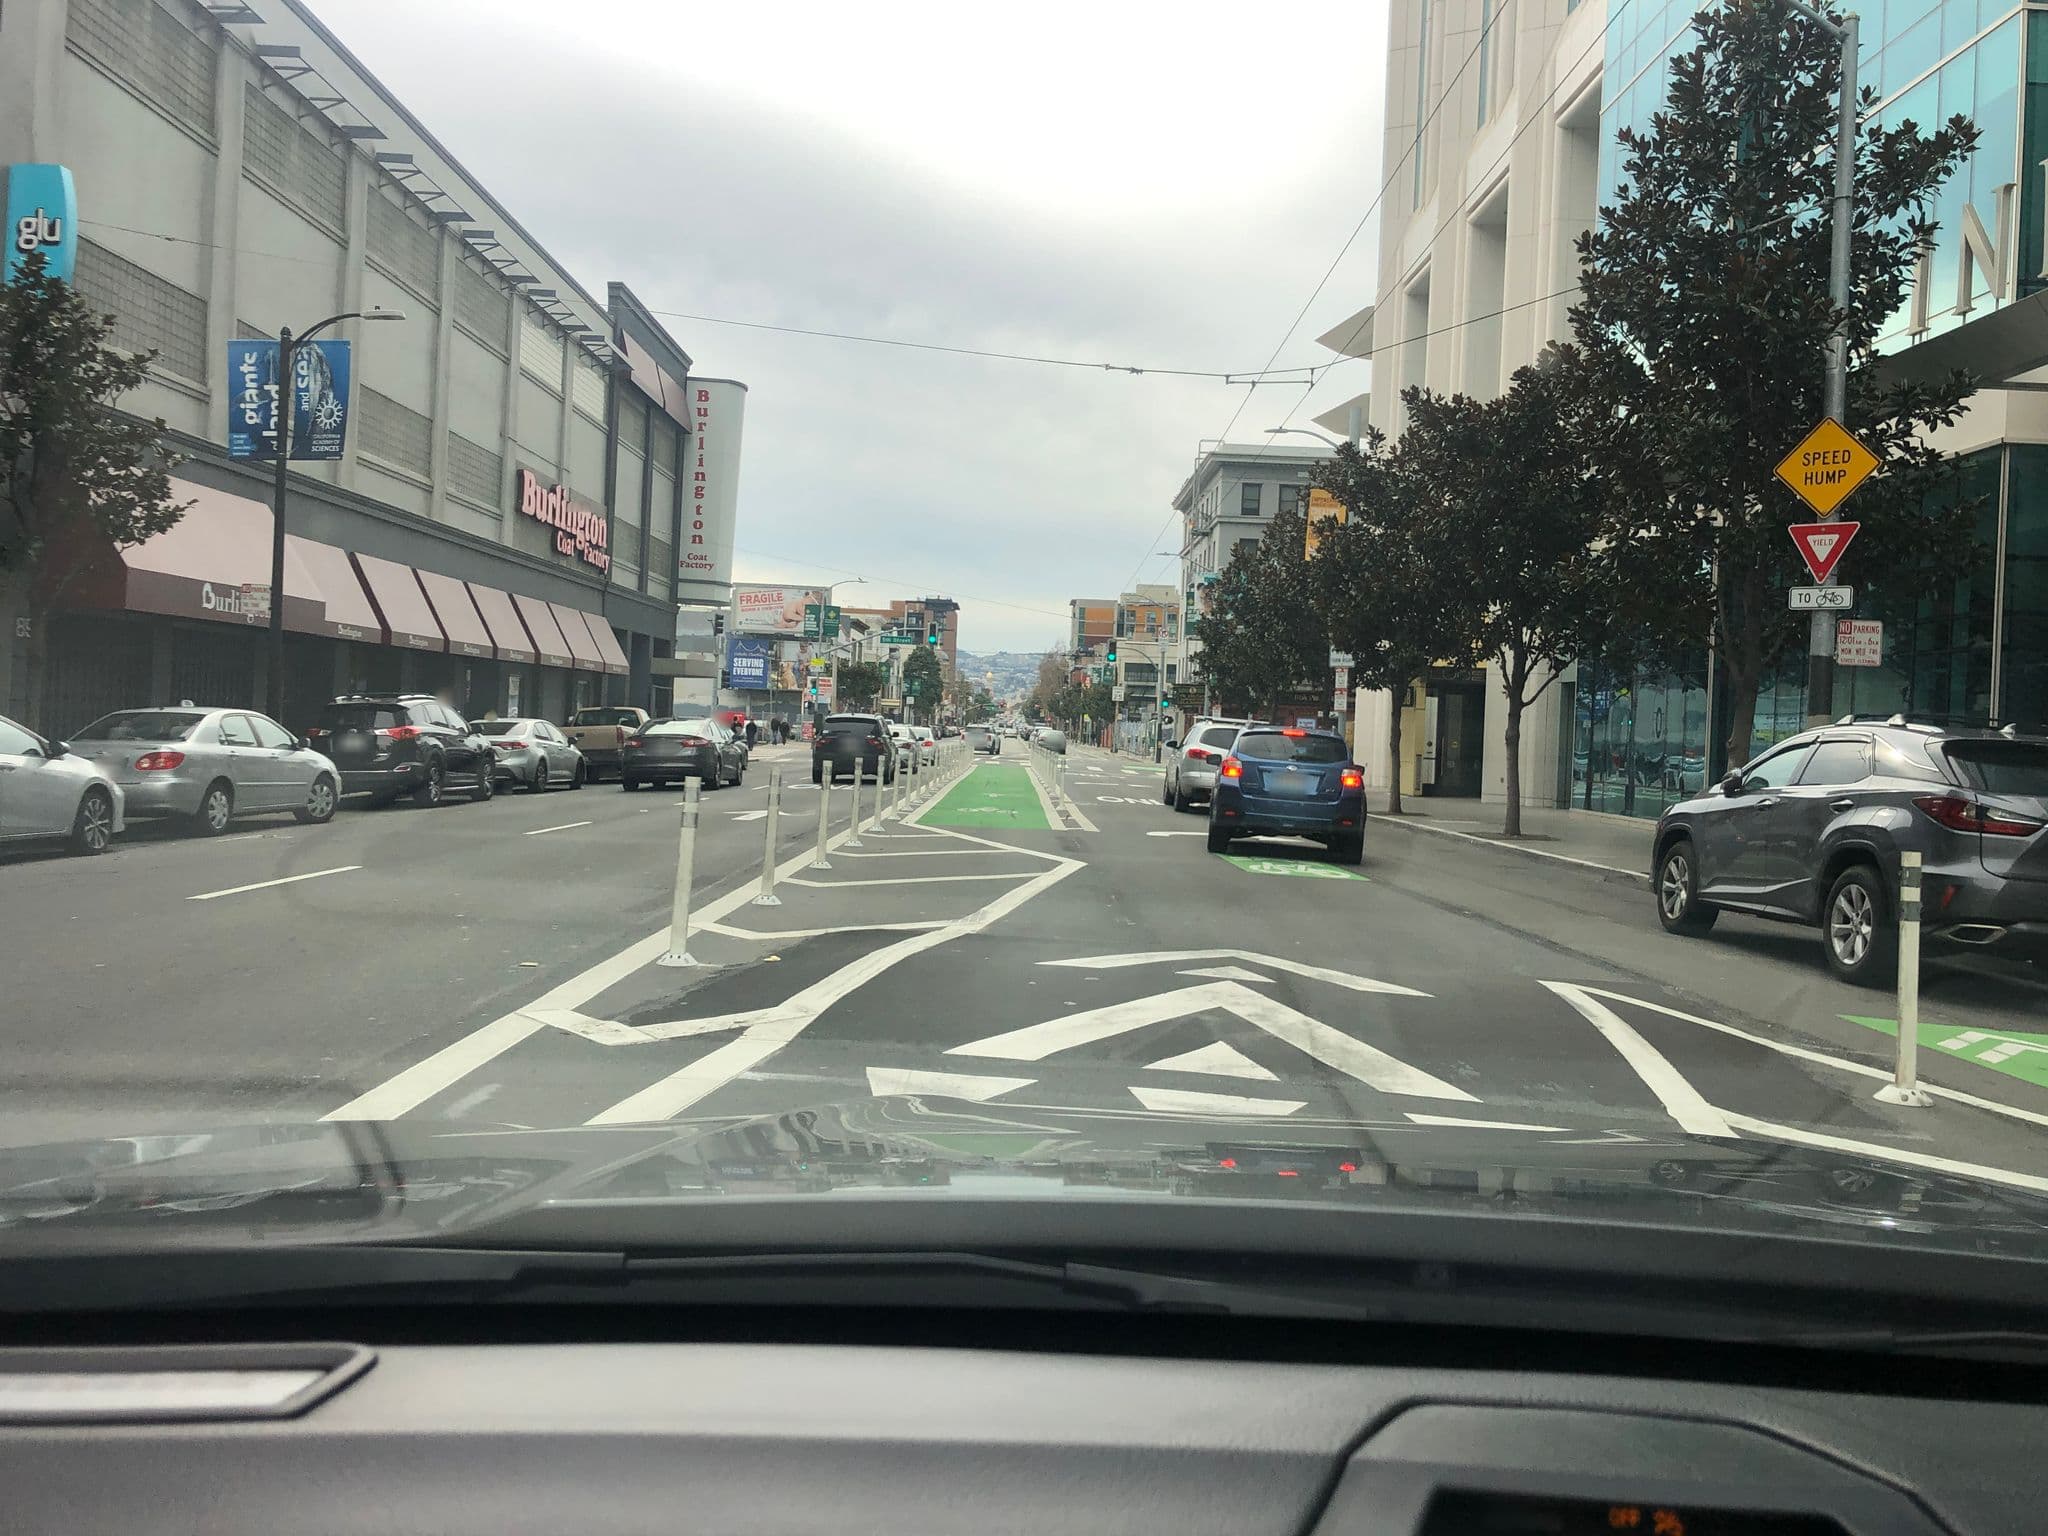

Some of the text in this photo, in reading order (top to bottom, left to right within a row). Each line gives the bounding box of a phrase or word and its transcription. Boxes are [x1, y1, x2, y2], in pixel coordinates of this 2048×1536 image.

[19, 208, 61, 250] glu
[1905, 159, 2048, 337] IN
[299, 392, 309, 411] and
[1802, 449, 1851, 467] SPEED
[691, 389, 710, 545] Burlington
[1804, 469, 1847, 486] HUMP
[522, 469, 607, 551] Burlington
[1812, 538, 1834, 547] YIELD
[557, 531, 610, 575] Coat Factory
[687, 552, 708, 561] Coat
[680, 560, 714, 571] Factory
[739, 592, 783, 605] FRAGILE
[1798, 592, 1811, 604] TO
[1840, 621, 1880, 634] NO PARKING
[733, 657, 764, 667] SERVING
[733, 667, 764, 676] EVERYONE
